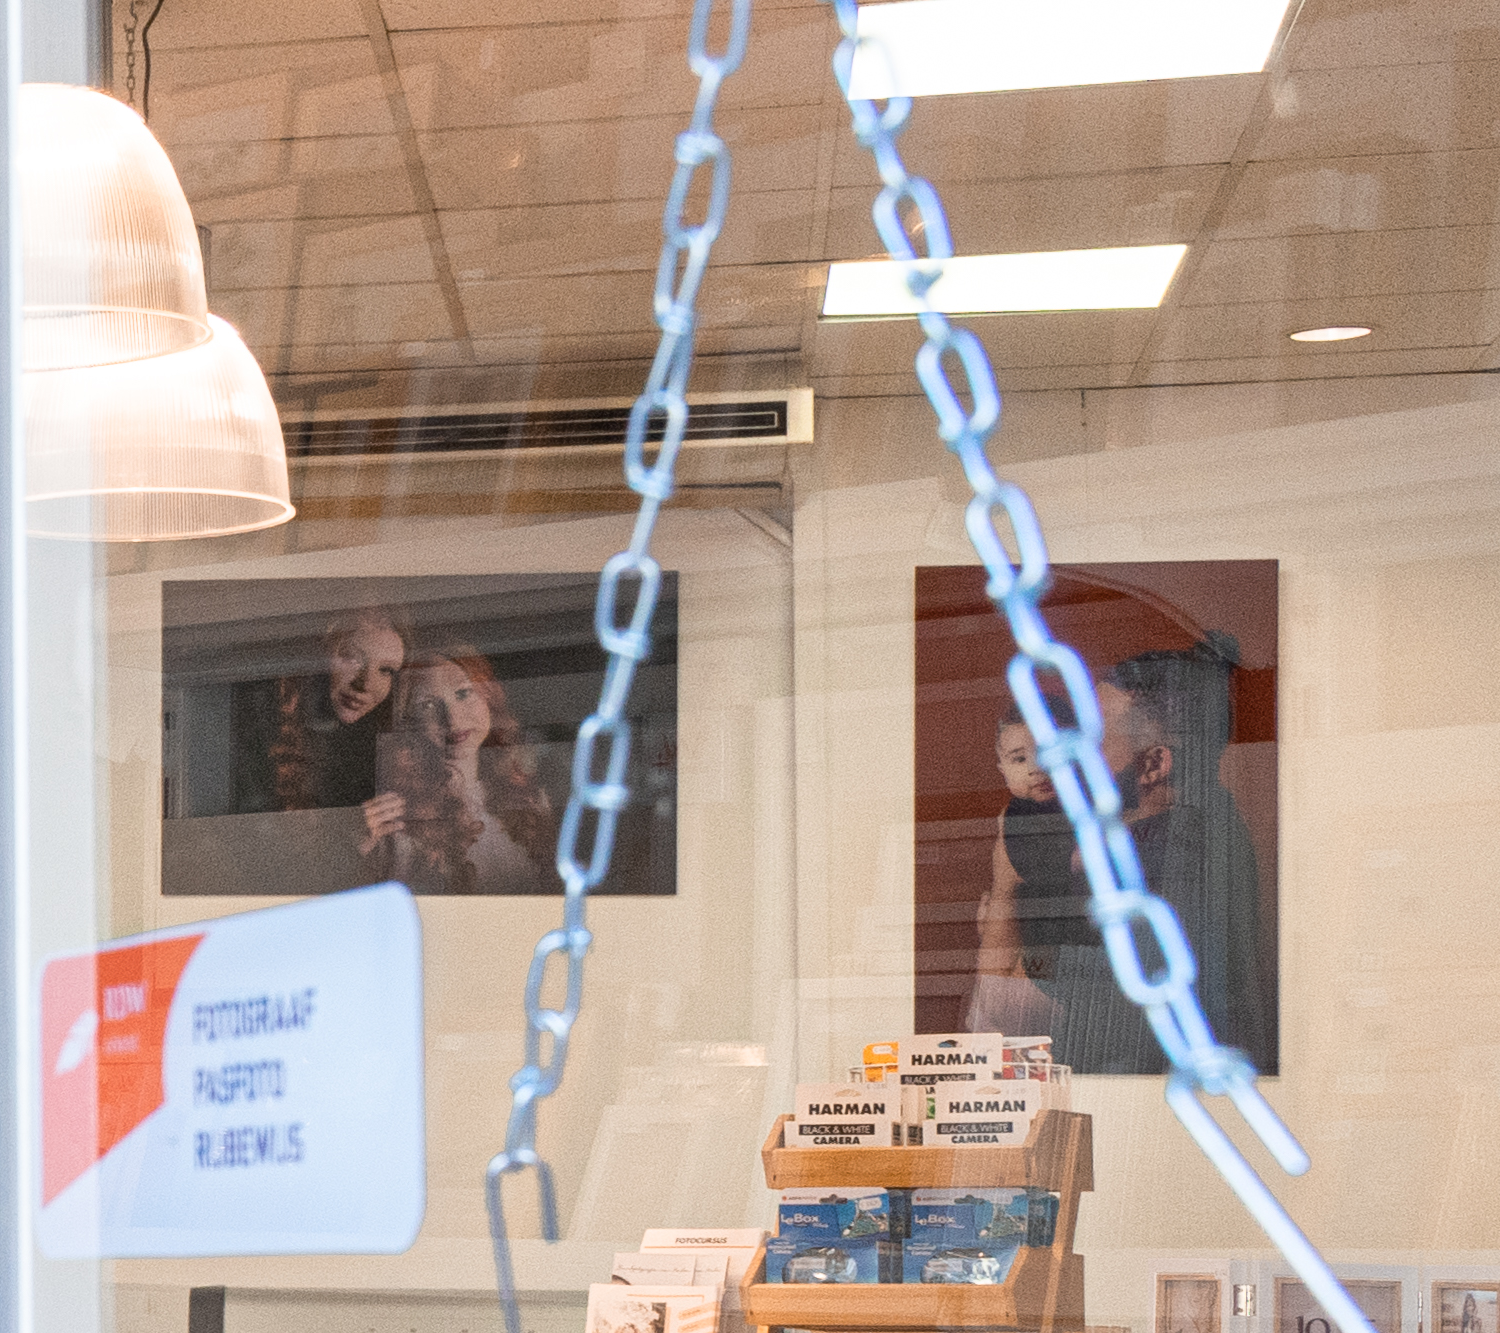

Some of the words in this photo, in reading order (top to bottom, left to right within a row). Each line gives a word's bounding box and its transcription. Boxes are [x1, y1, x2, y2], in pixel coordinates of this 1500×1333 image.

[911, 1053, 988, 1066] HARMAN
[904, 1074, 930, 1084] BLACK
[808, 1102, 886, 1116] HARMAN
[948, 1100, 1026, 1114] HARMAN
[802, 1124, 831, 1134] BLACK
[842, 1124, 871, 1134] WHITE
[940, 1122, 969, 1133] BLACK
[979, 1122, 1010, 1132] WHITE
[813, 1136, 861, 1145] CAMERA
[951, 1134, 999, 1144] CAMERA
[675, 1236, 728, 1245] FOTOCURSUS
